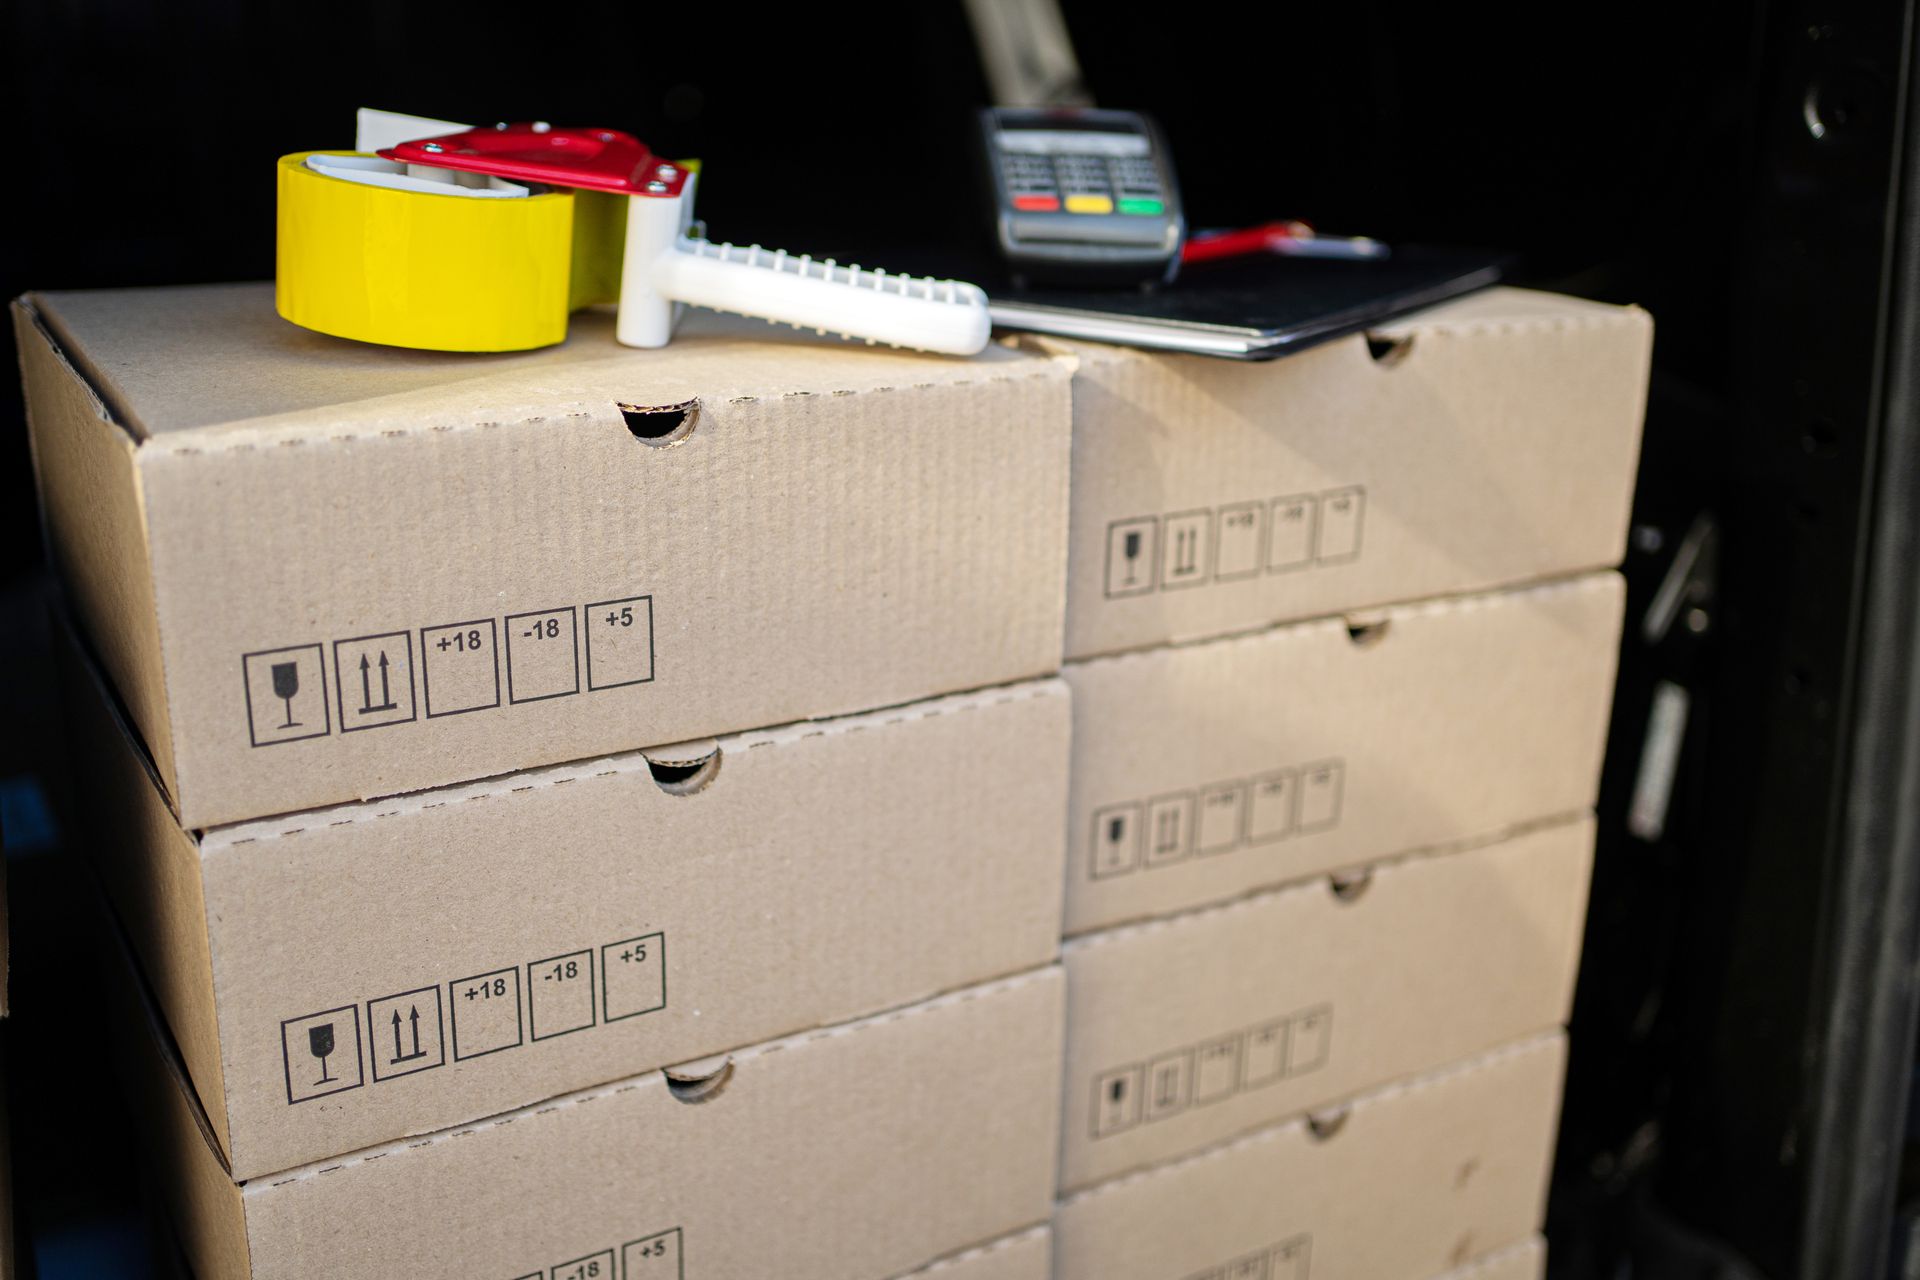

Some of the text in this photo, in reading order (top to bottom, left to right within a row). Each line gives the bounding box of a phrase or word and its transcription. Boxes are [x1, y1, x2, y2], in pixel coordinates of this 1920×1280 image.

[436, 607, 633, 652] +18 -18 +5
[464, 945, 647, 1001] +18 -18 +5
[640, 1239, 665, 1258] +5
